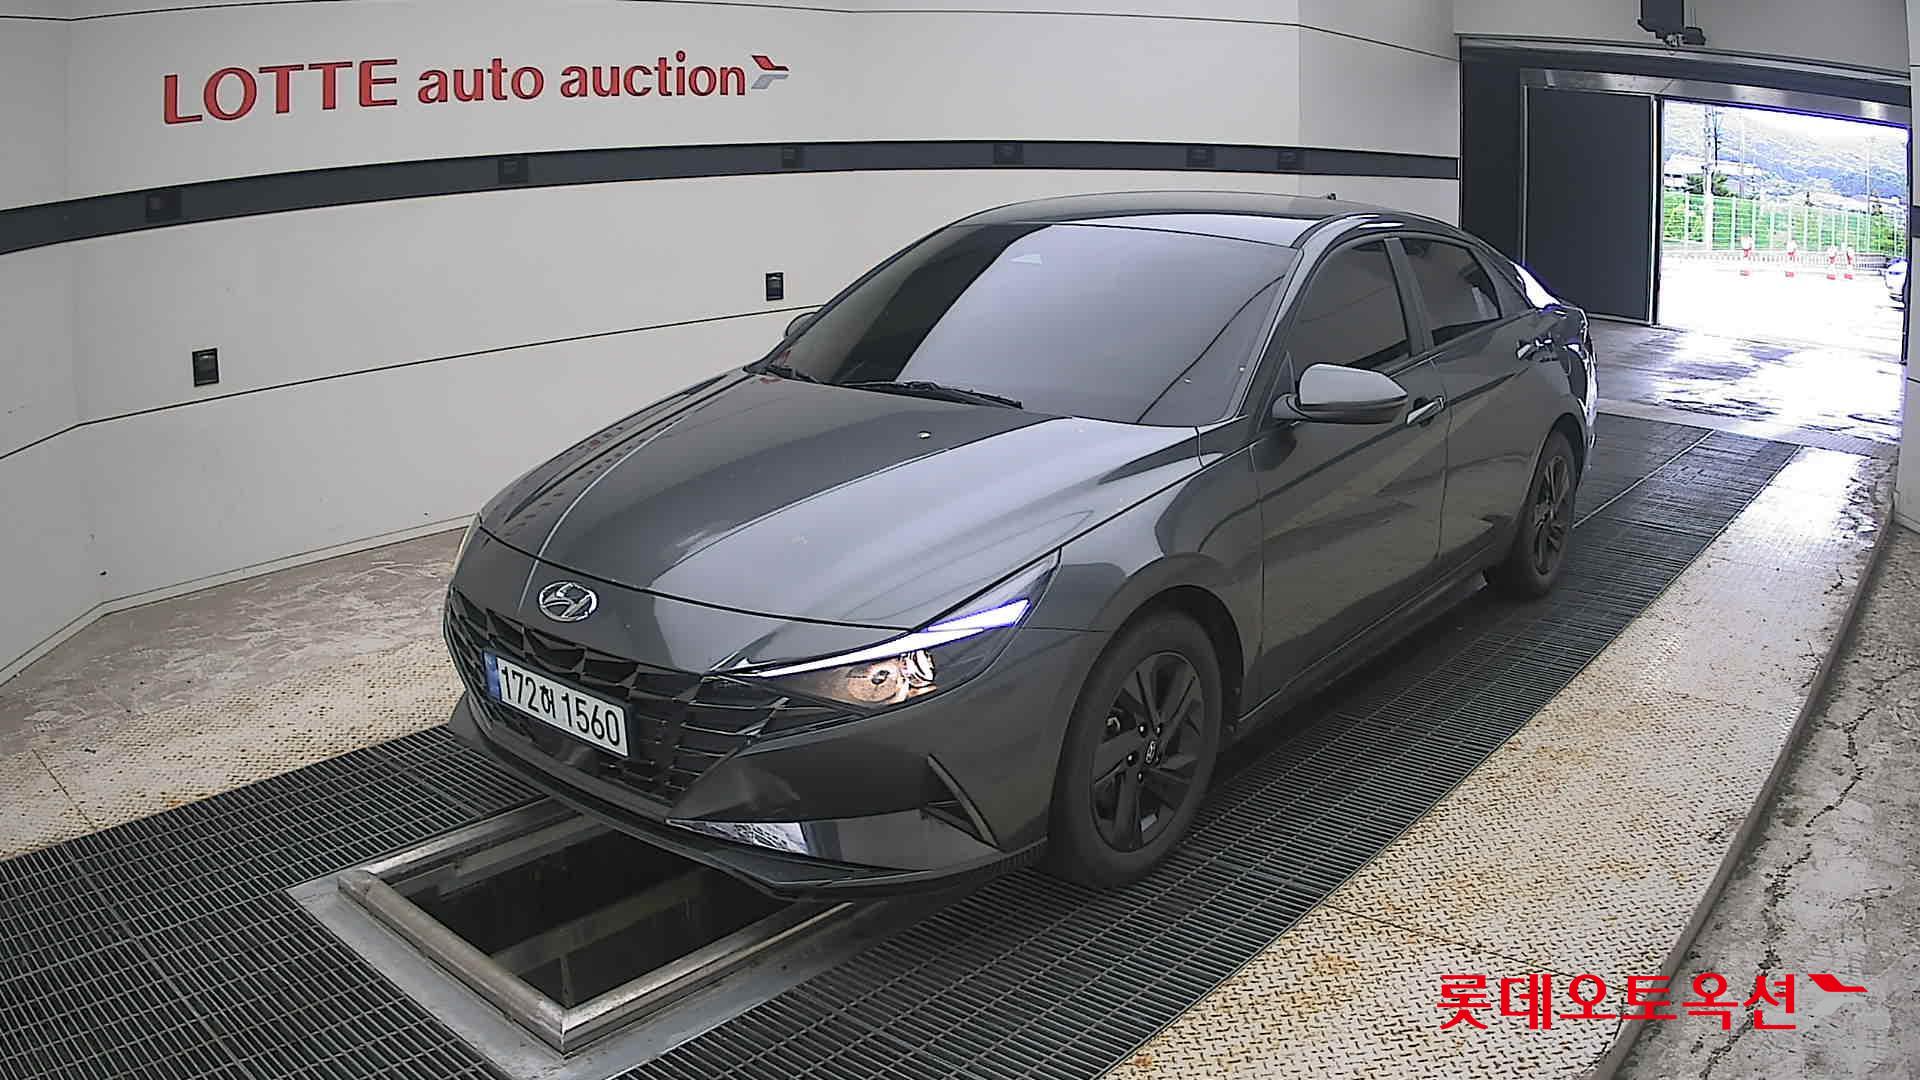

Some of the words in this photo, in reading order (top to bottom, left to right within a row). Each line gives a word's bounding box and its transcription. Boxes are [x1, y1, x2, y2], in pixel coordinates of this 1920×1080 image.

[163, 58, 398, 125] LOTTE
[417, 57, 545, 104] auto
[559, 50, 747, 98] auction
[561, 692, 621, 747] 1560
